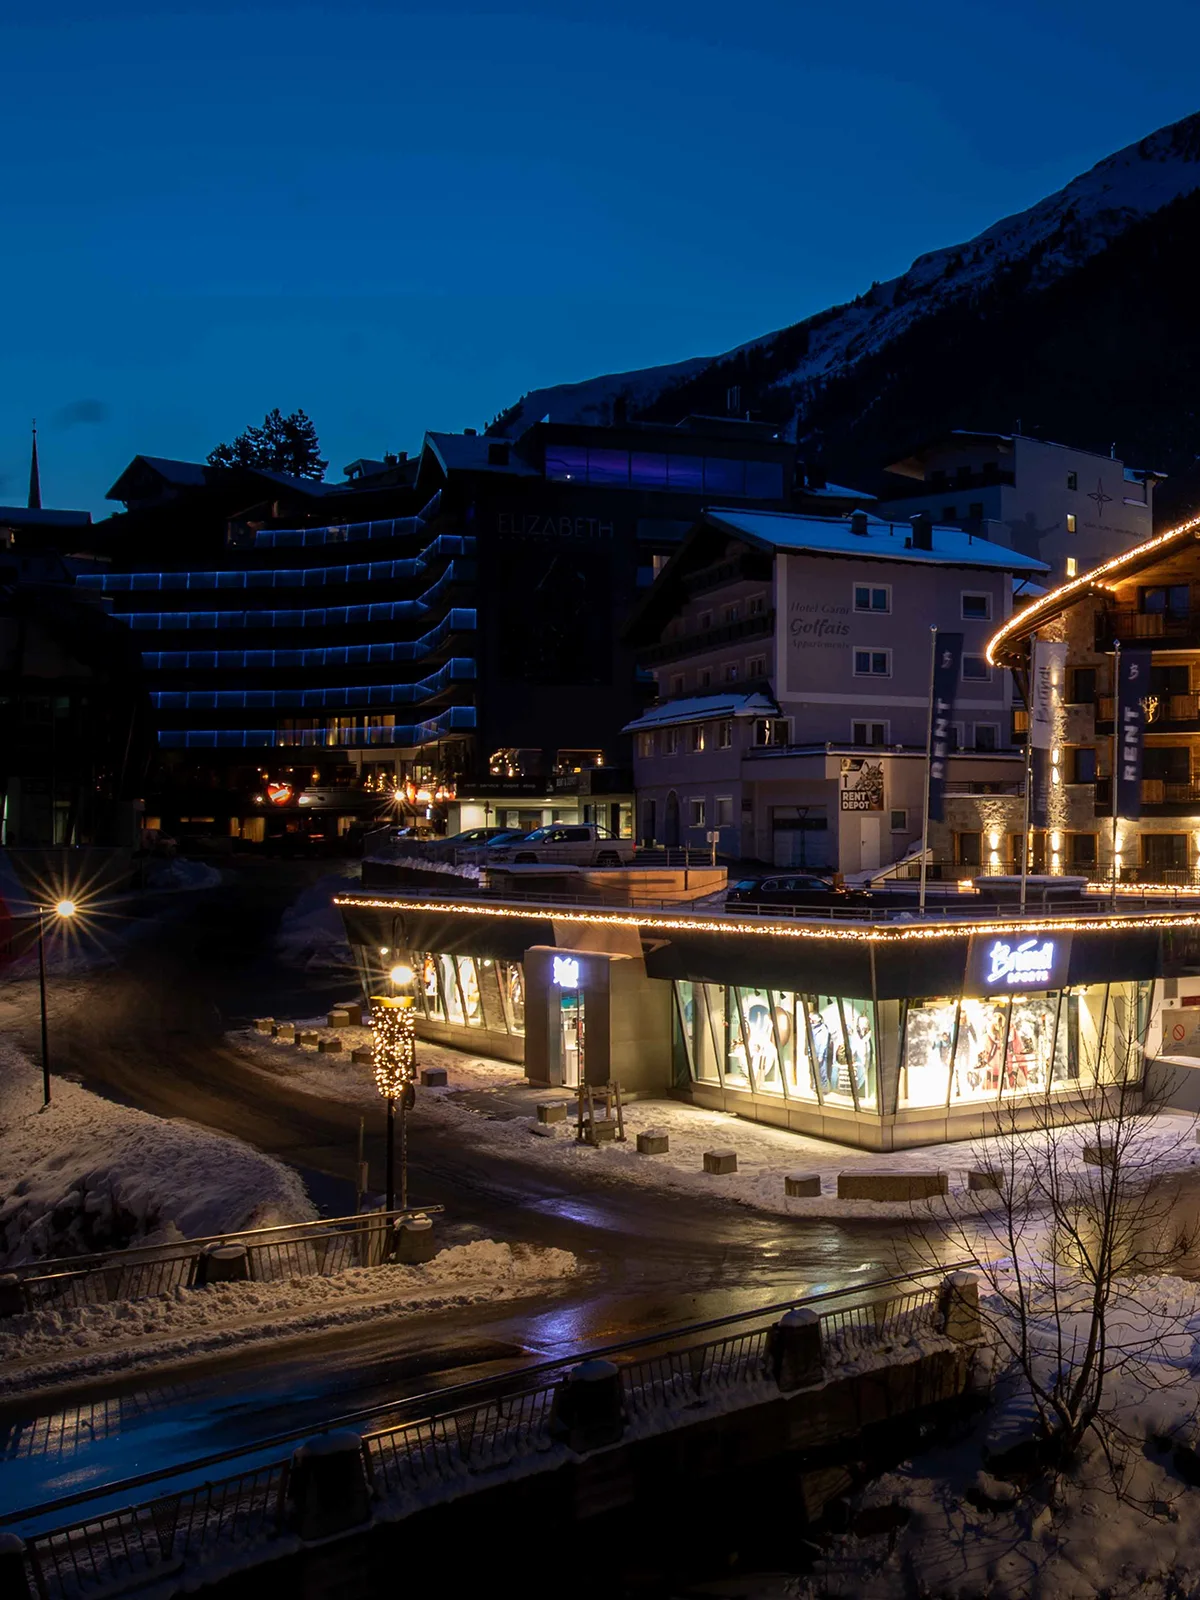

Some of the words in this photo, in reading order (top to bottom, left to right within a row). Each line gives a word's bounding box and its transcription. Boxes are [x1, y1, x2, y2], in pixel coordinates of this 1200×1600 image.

[496, 512, 614, 539] ELIZABETH
[790, 601, 818, 613] Hotel
[790, 618, 851, 637] Golfais
[1123, 706, 1140, 782] RENT
[842, 791, 867, 801] RENT
[842, 801, 870, 810] DEPOT
